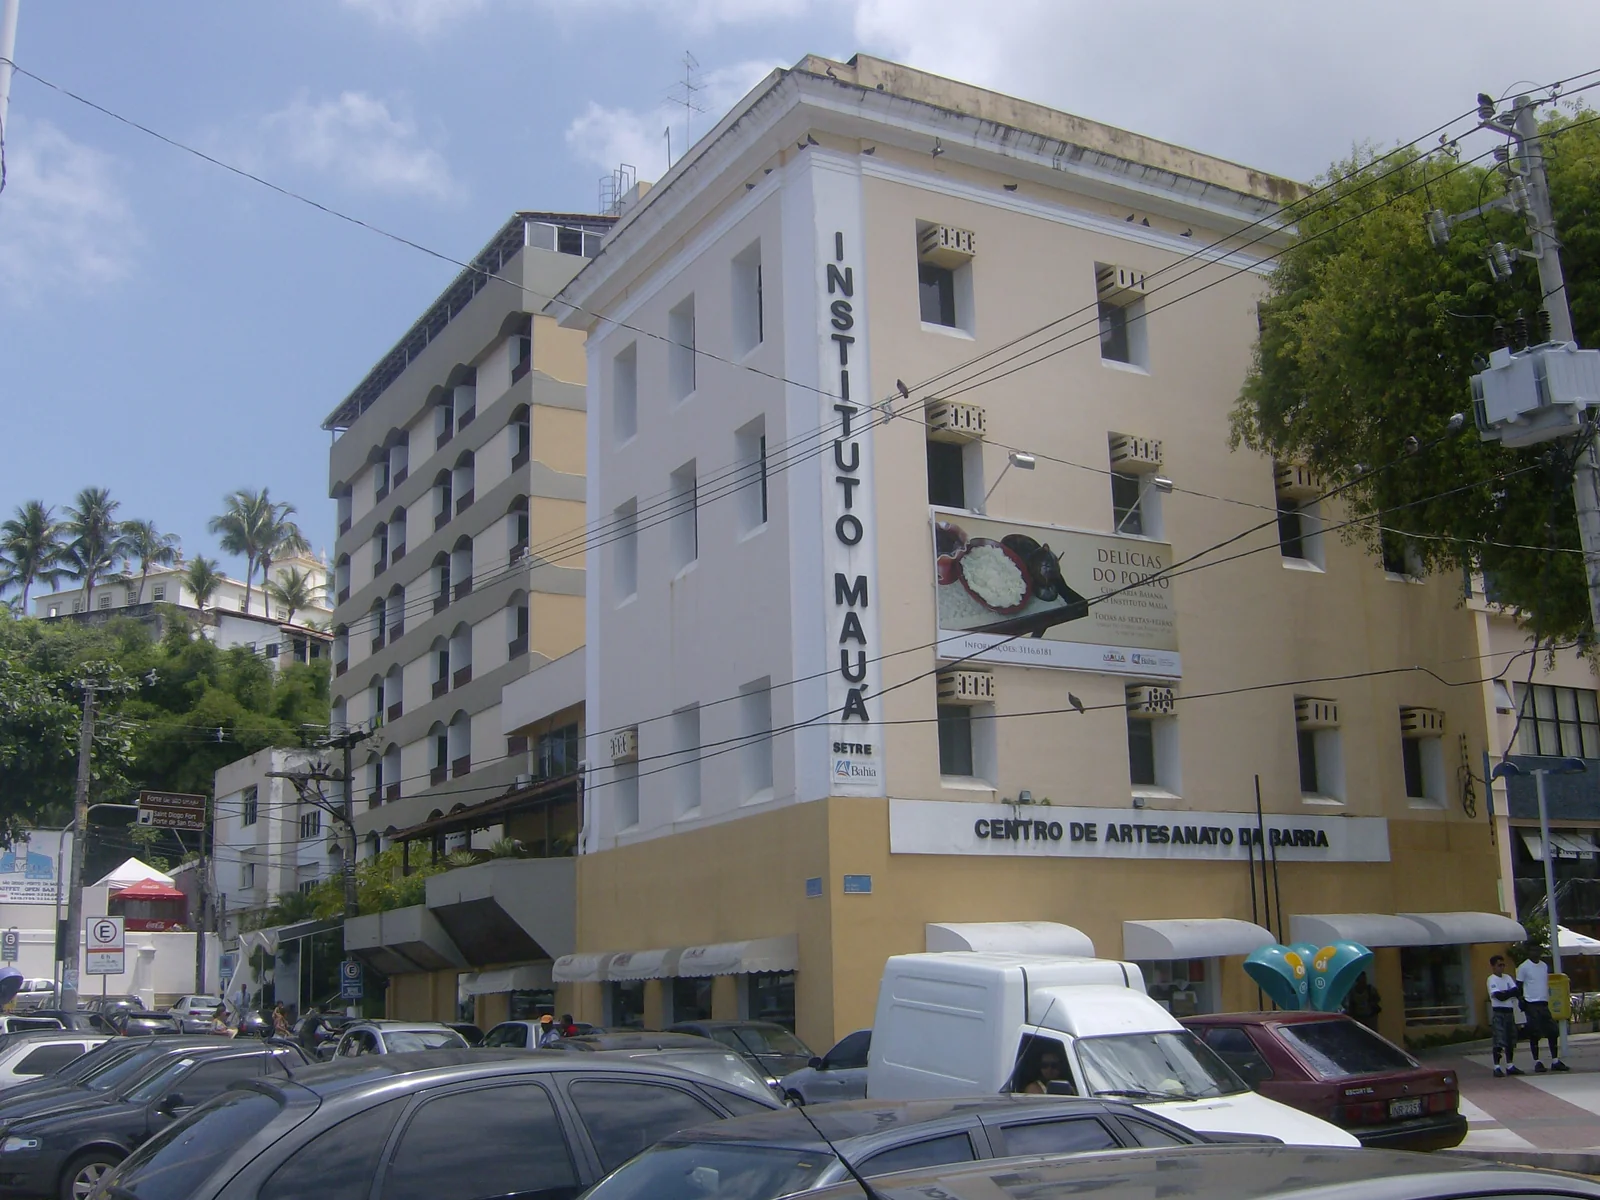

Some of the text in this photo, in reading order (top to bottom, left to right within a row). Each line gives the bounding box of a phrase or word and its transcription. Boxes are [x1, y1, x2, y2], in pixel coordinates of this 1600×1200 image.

[827, 231, 863, 546] INSTITUTO
[1097, 549, 1162, 569] DELÍCIAS
[1093, 568, 1169, 589] DO PORTO
[1139, 591, 1164, 600] BAIANA
[1110, 597, 1147, 608] INSTITUTO
[834, 572, 870, 722] MAUÁ
[1019, 645, 1052, 656] 3116.6181
[833, 742, 872, 755] SETRE
[851, 766, 876, 776] Bahia
[146, 794, 162, 802] Forte
[154, 810, 197, 820] Saint Diogo Fort
[974, 818, 1064, 842] CENTRO
[1069, 822, 1098, 842] DE
[1104, 823, 1235, 846] ARTESANATO
[1268, 828, 1329, 848] BARRA
[100, 925, 111, 938] E
[1315, 956, 1327, 969] oi
[349, 966, 355, 974] E
